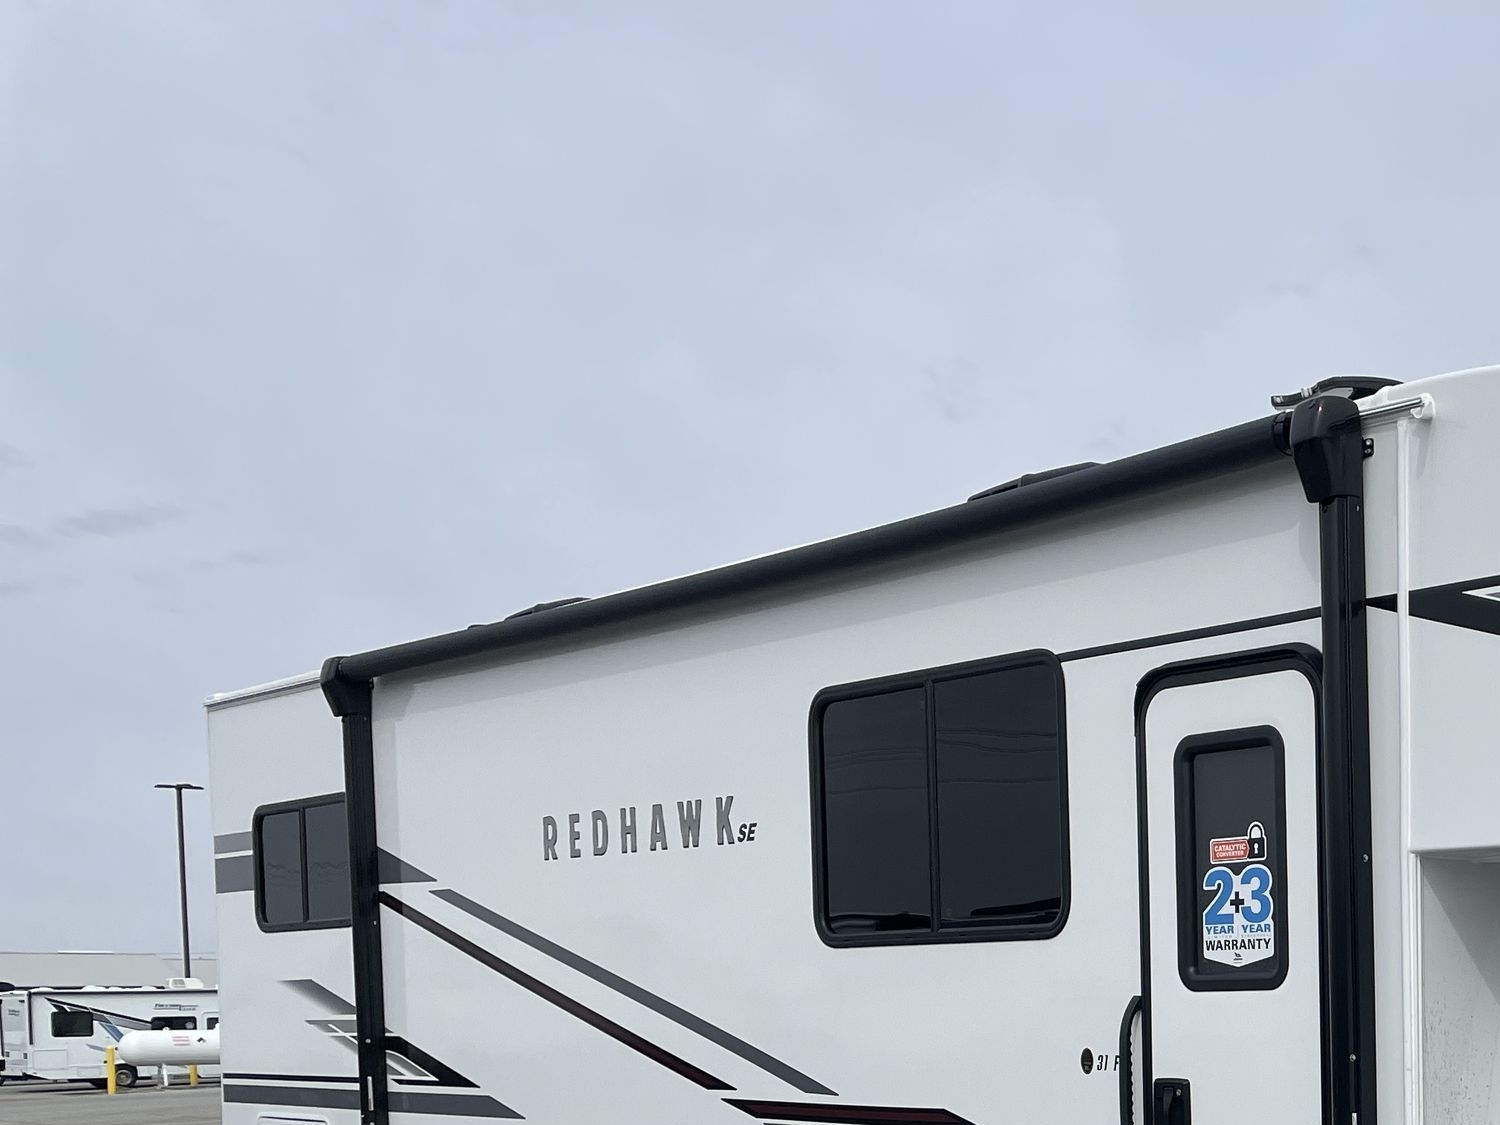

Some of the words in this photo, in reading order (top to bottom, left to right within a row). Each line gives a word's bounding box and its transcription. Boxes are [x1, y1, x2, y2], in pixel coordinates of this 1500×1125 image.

[542, 795, 735, 861] REDHAWK
[737, 822, 757, 842] SE
[1214, 843, 1247, 852] CATALYTIC
[1205, 925, 1235, 935] YEAR
[1241, 923, 1271, 933] YEAR
[1205, 937, 1271, 951] WARRANTY
